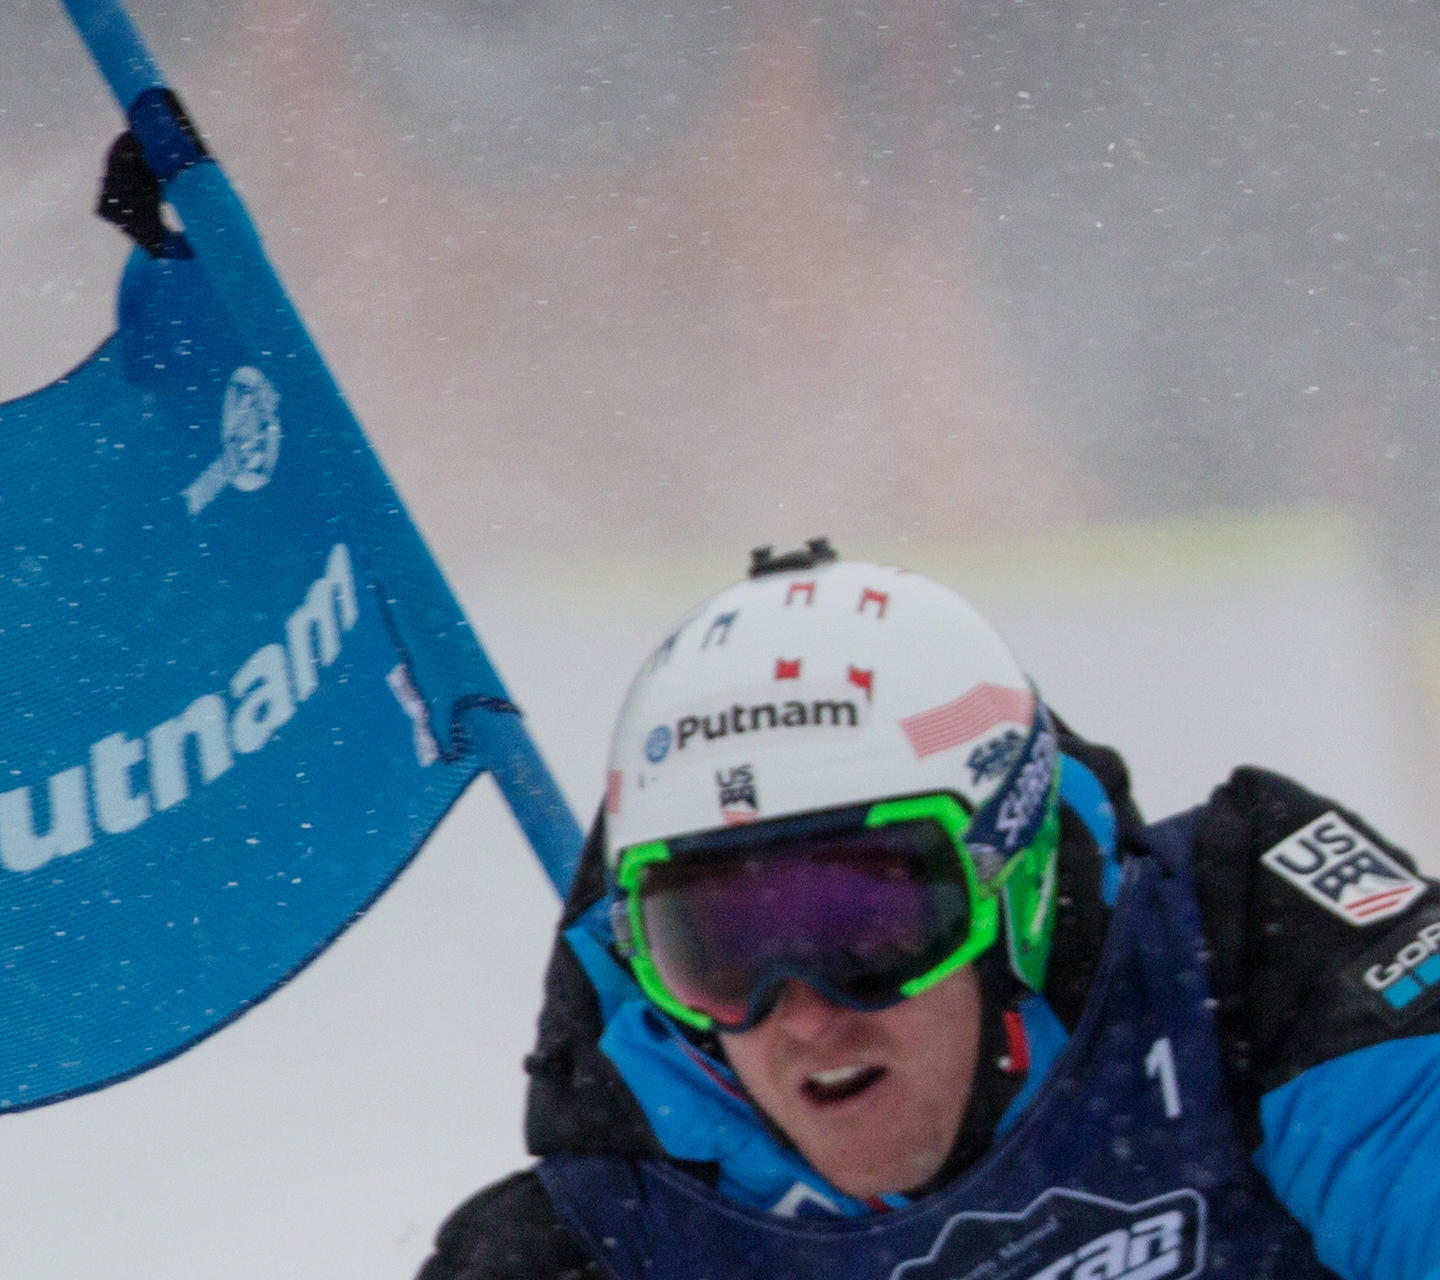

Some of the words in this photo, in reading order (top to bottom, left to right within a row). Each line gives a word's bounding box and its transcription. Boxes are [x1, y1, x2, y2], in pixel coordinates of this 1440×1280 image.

[676, 698, 859, 750] Putnam
[1275, 821, 1356, 876] US
[1145, 1036, 1182, 1119] 1
